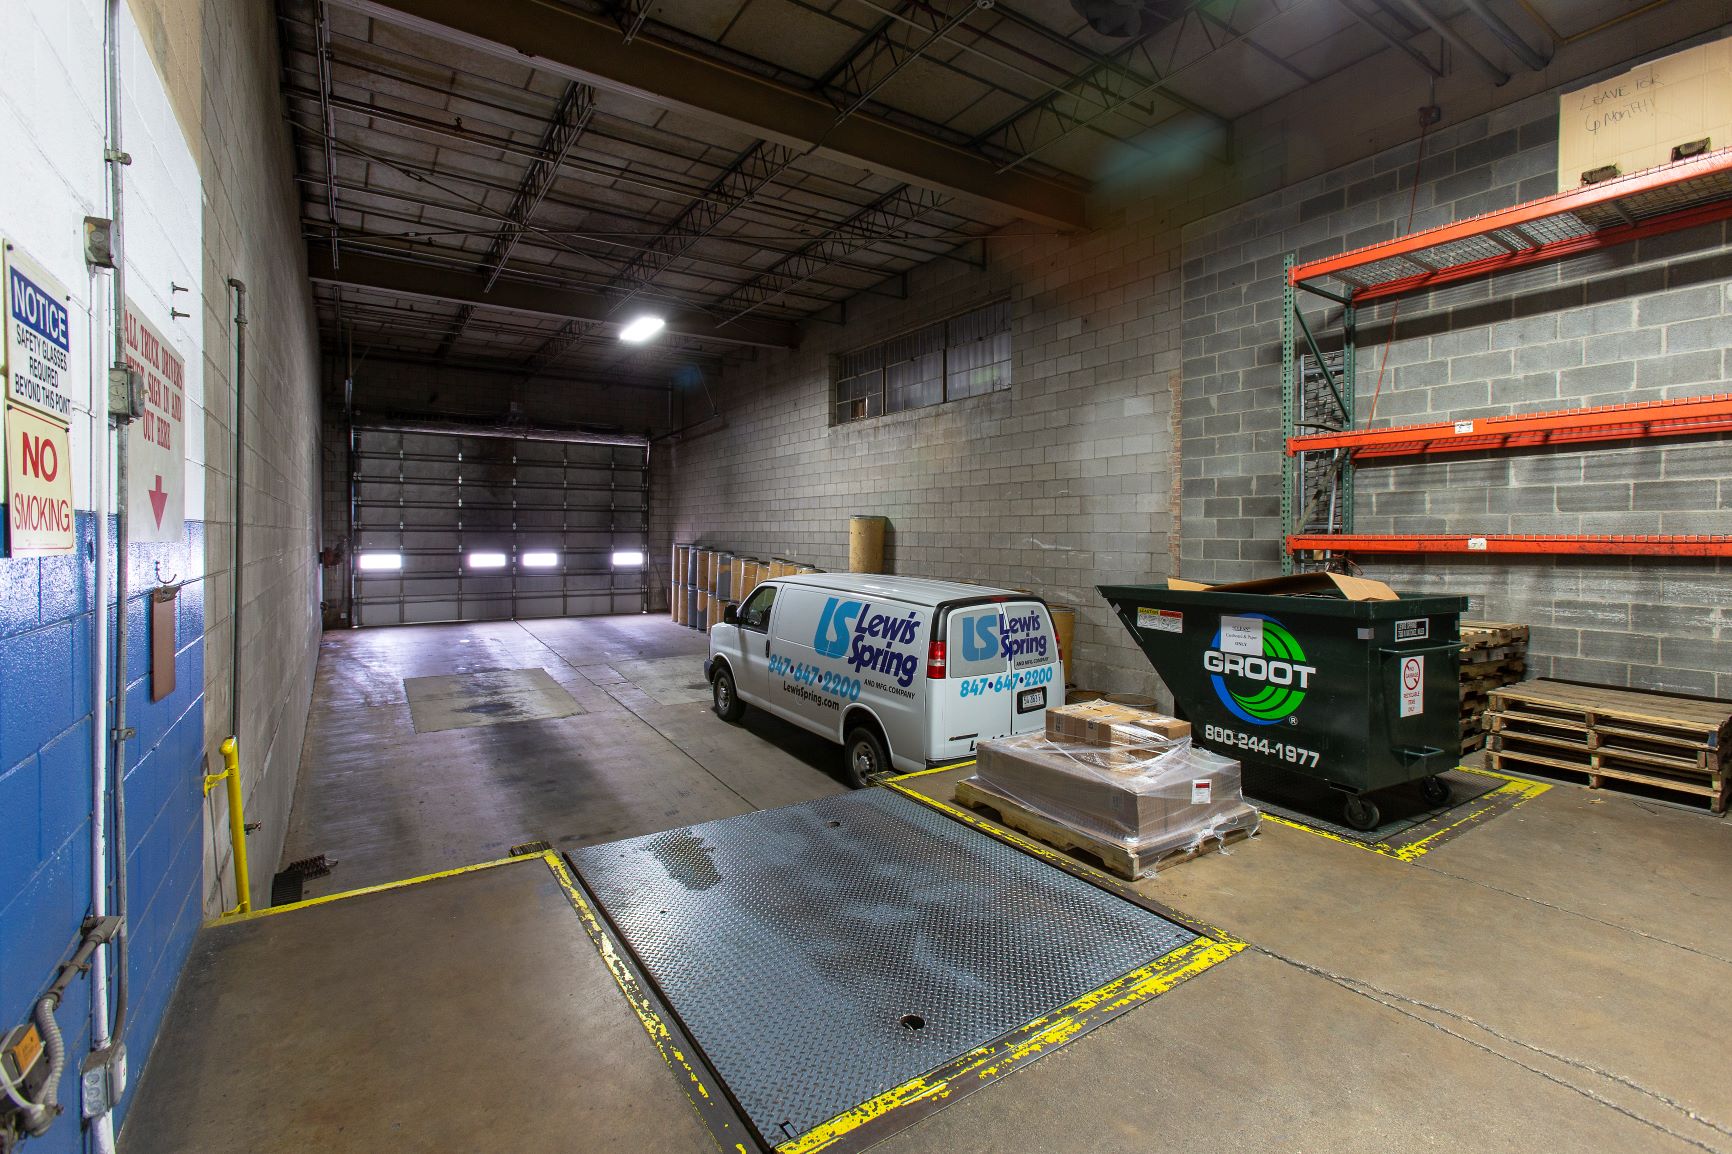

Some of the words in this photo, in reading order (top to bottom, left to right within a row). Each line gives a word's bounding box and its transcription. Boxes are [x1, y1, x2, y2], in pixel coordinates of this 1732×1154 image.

[14, 276, 67, 345] NOTICE
[17, 324, 42, 355] SAFETY
[43, 338, 67, 372] GLASSES
[125, 309, 138, 352] ALL
[141, 324, 160, 371] TRUCK
[162, 346, 183, 391] DRIVERS
[29, 356, 58, 388] REQUIRED
[15, 373, 40, 401] BEYOND
[41, 386, 54, 409] THIS
[56, 393, 70, 416] POINT
[148, 371, 161, 409] SIGN
[163, 384, 170, 415] IN
[172, 394, 182, 422] AND
[143, 408, 154, 443] OUT
[157, 415, 171, 450] HERE
[22, 431, 58, 483] NO
[14, 492, 70, 533] SMOKING
[855, 603, 922, 645] Lewis
[999, 610, 1041, 635] Lewis
[848, 633, 919, 688] Spring
[1000, 632, 1047, 661] Spring
[863, 678, 875, 687] AND
[888, 686, 916, 700] COMPANY
[1203, 650, 1317, 689] GROOT
[783, 681, 840, 710] LewisSpring.com
[1205, 724, 1320, 768] 800-244-1977
